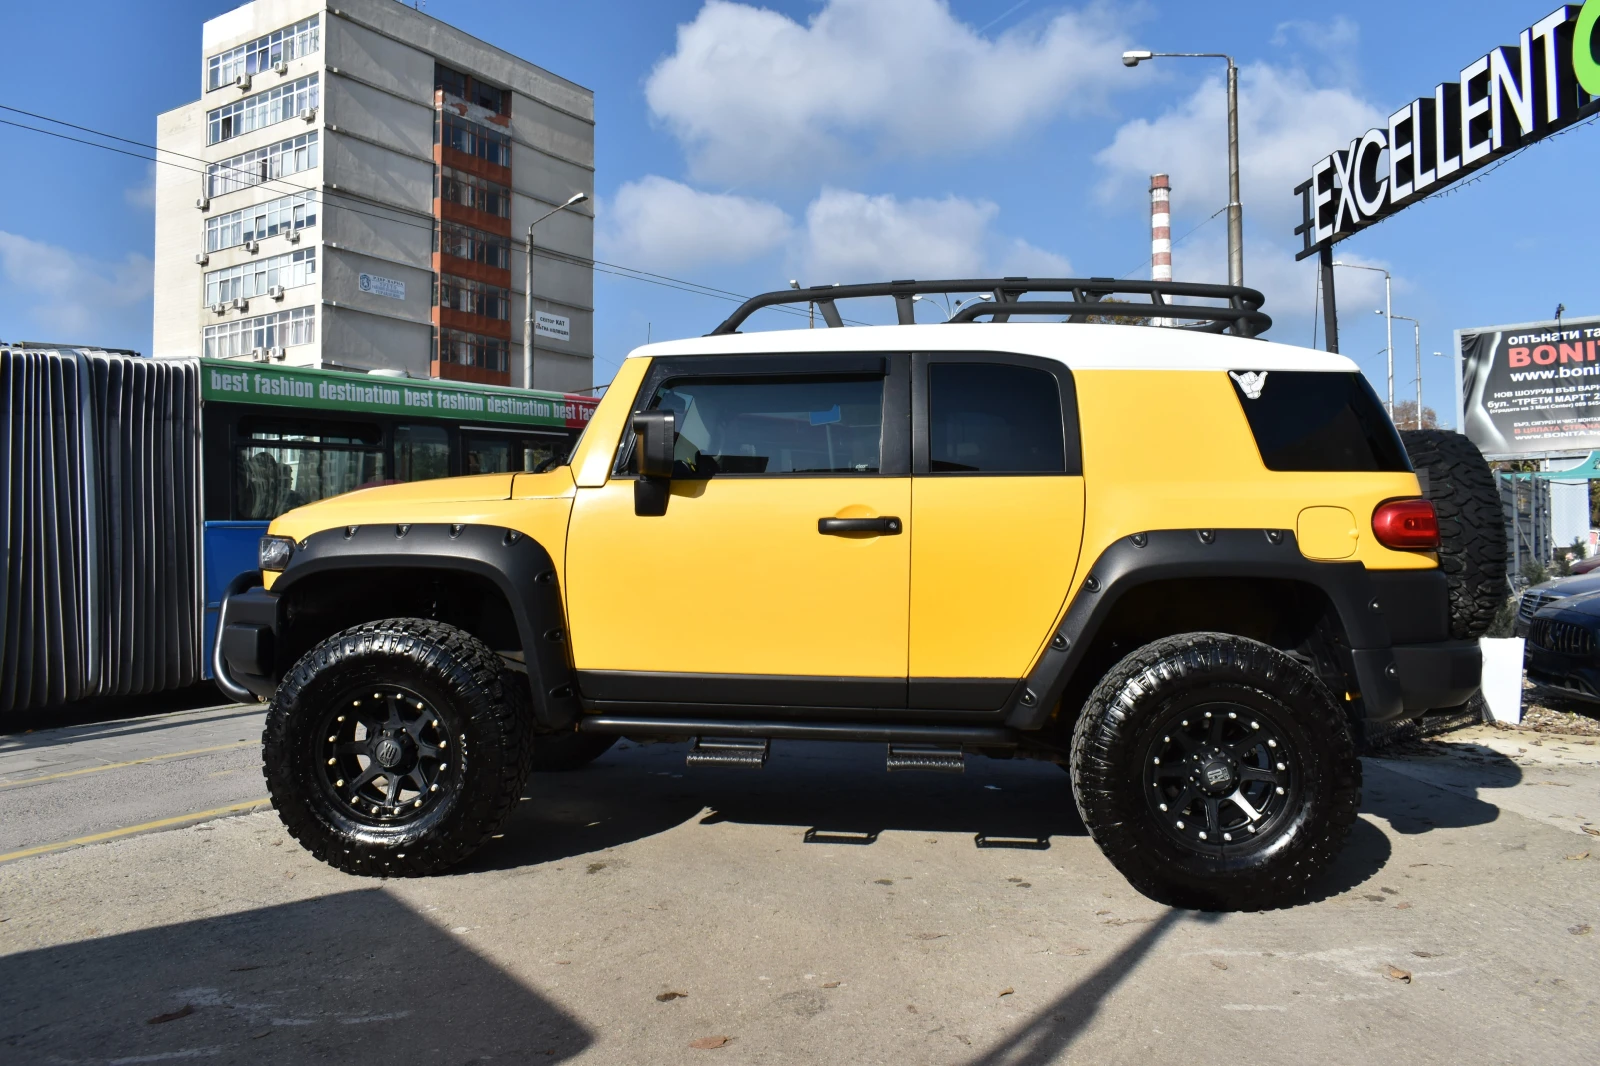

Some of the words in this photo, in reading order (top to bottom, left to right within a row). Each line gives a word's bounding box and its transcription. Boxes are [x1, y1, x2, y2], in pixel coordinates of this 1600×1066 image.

[1312, 5, 1569, 243] EXCELLENT
[555, 319, 565, 327] КАТ
[211, 370, 250, 393] best
[254, 373, 314, 399] fashion
[319, 381, 400, 405] destination
[404, 388, 433, 408] best
[437, 392, 484, 412] fashion
[487, 395, 550, 418] destination
[553, 402, 576, 420] best
[1494, 391, 1513, 399] НОВ
[1515, 388, 1554, 397] ШОУРУМ
[1556, 386, 1576, 394] ВЪВ
[1487, 400, 1509, 409] бул.
